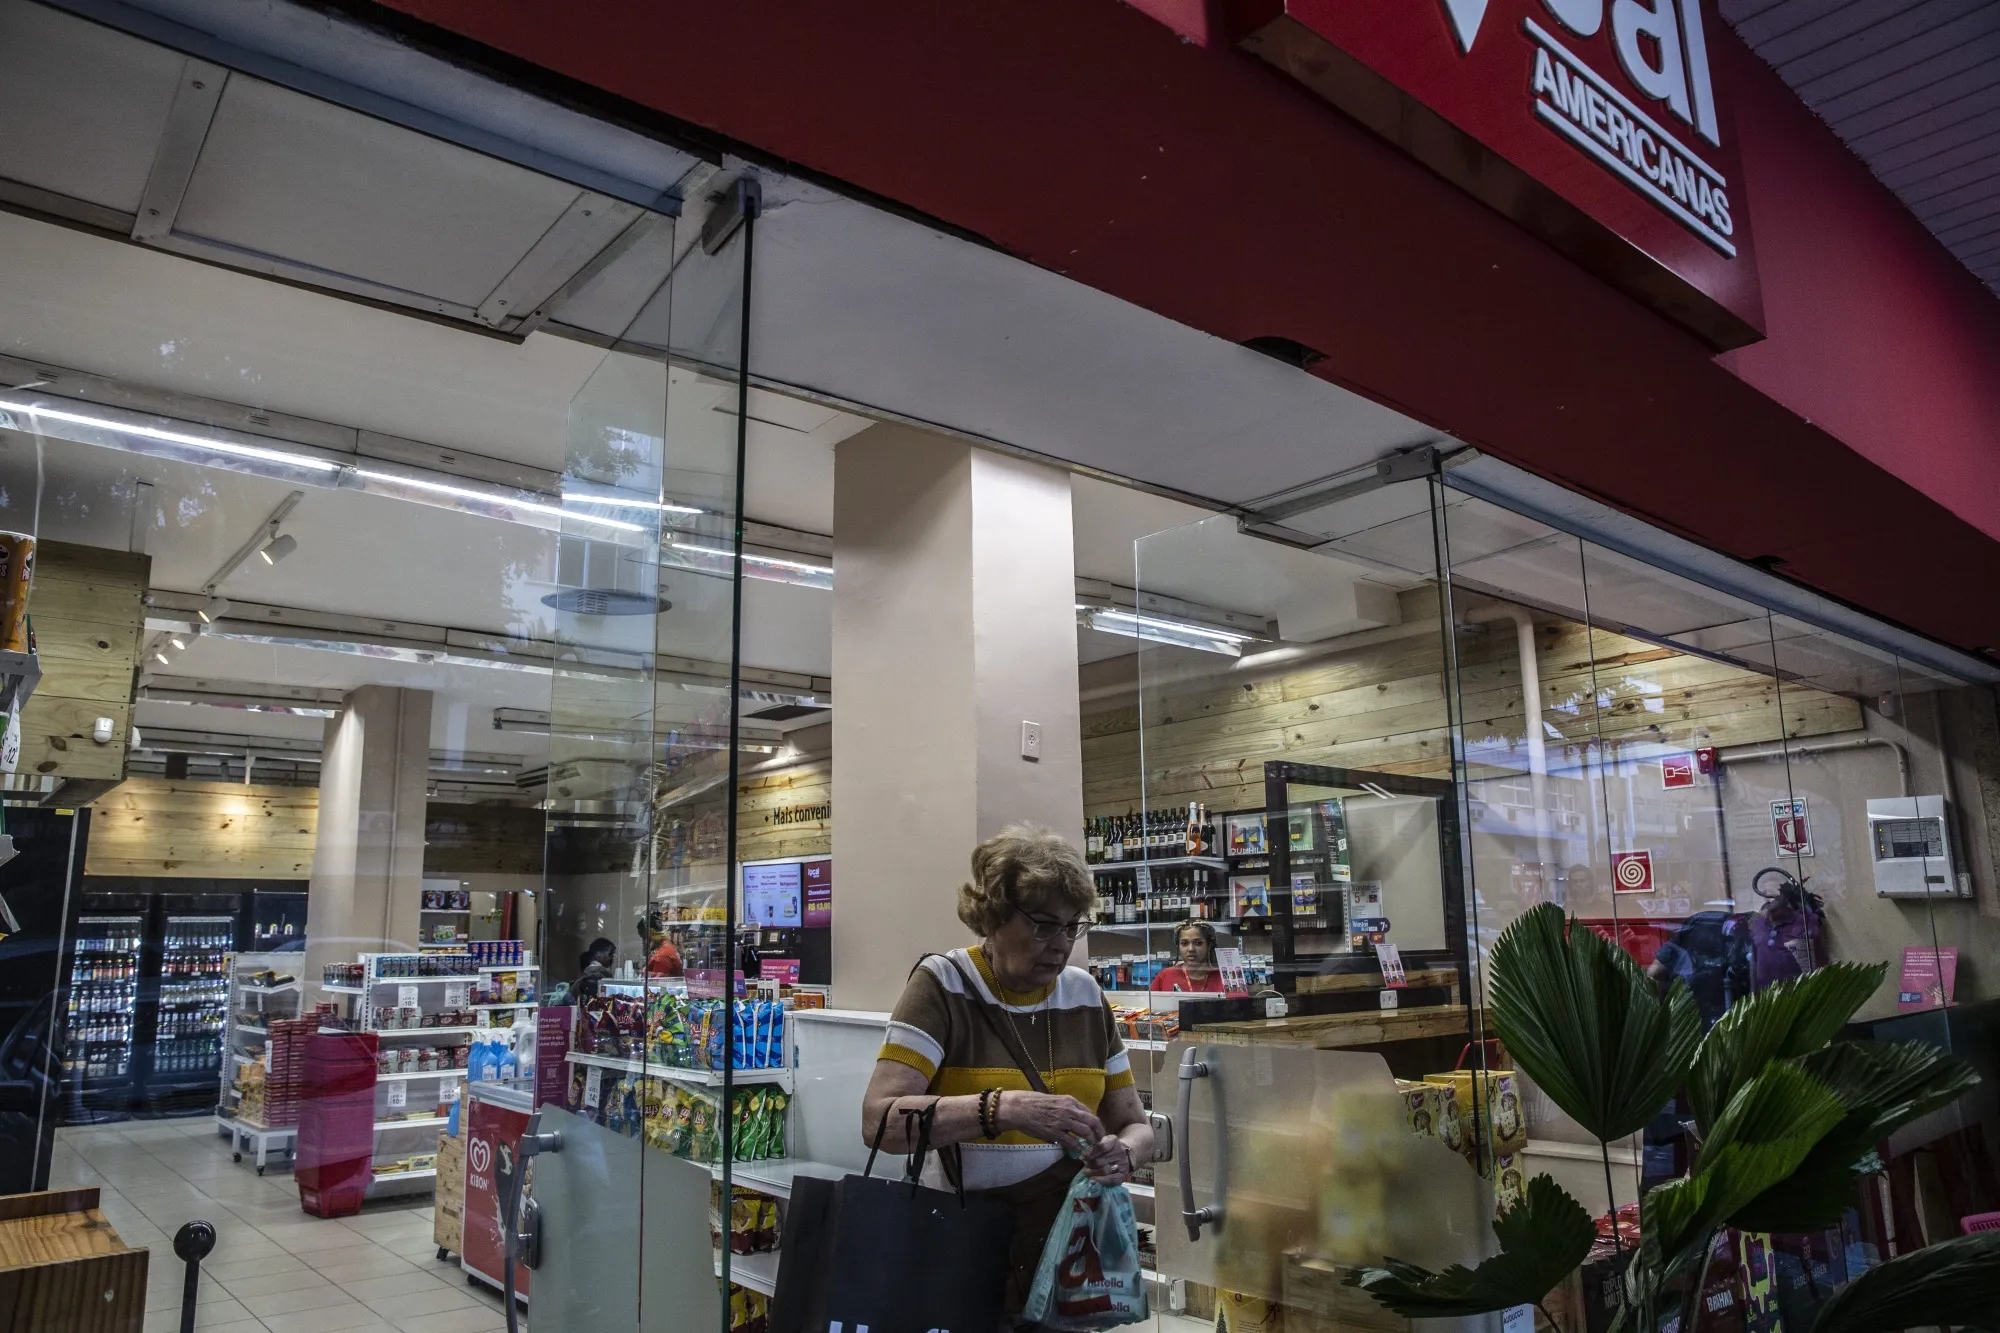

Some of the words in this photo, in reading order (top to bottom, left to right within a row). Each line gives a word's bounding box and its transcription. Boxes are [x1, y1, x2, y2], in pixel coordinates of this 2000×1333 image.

[1532, 46, 1734, 236] AMERICANAS
[773, 806, 793, 825] Mais
[470, 1173, 489, 1191] KIBON
[1706, 1289, 1734, 1313] BRAHMA
[1503, 1308, 1524, 1325] AUDUCCO
